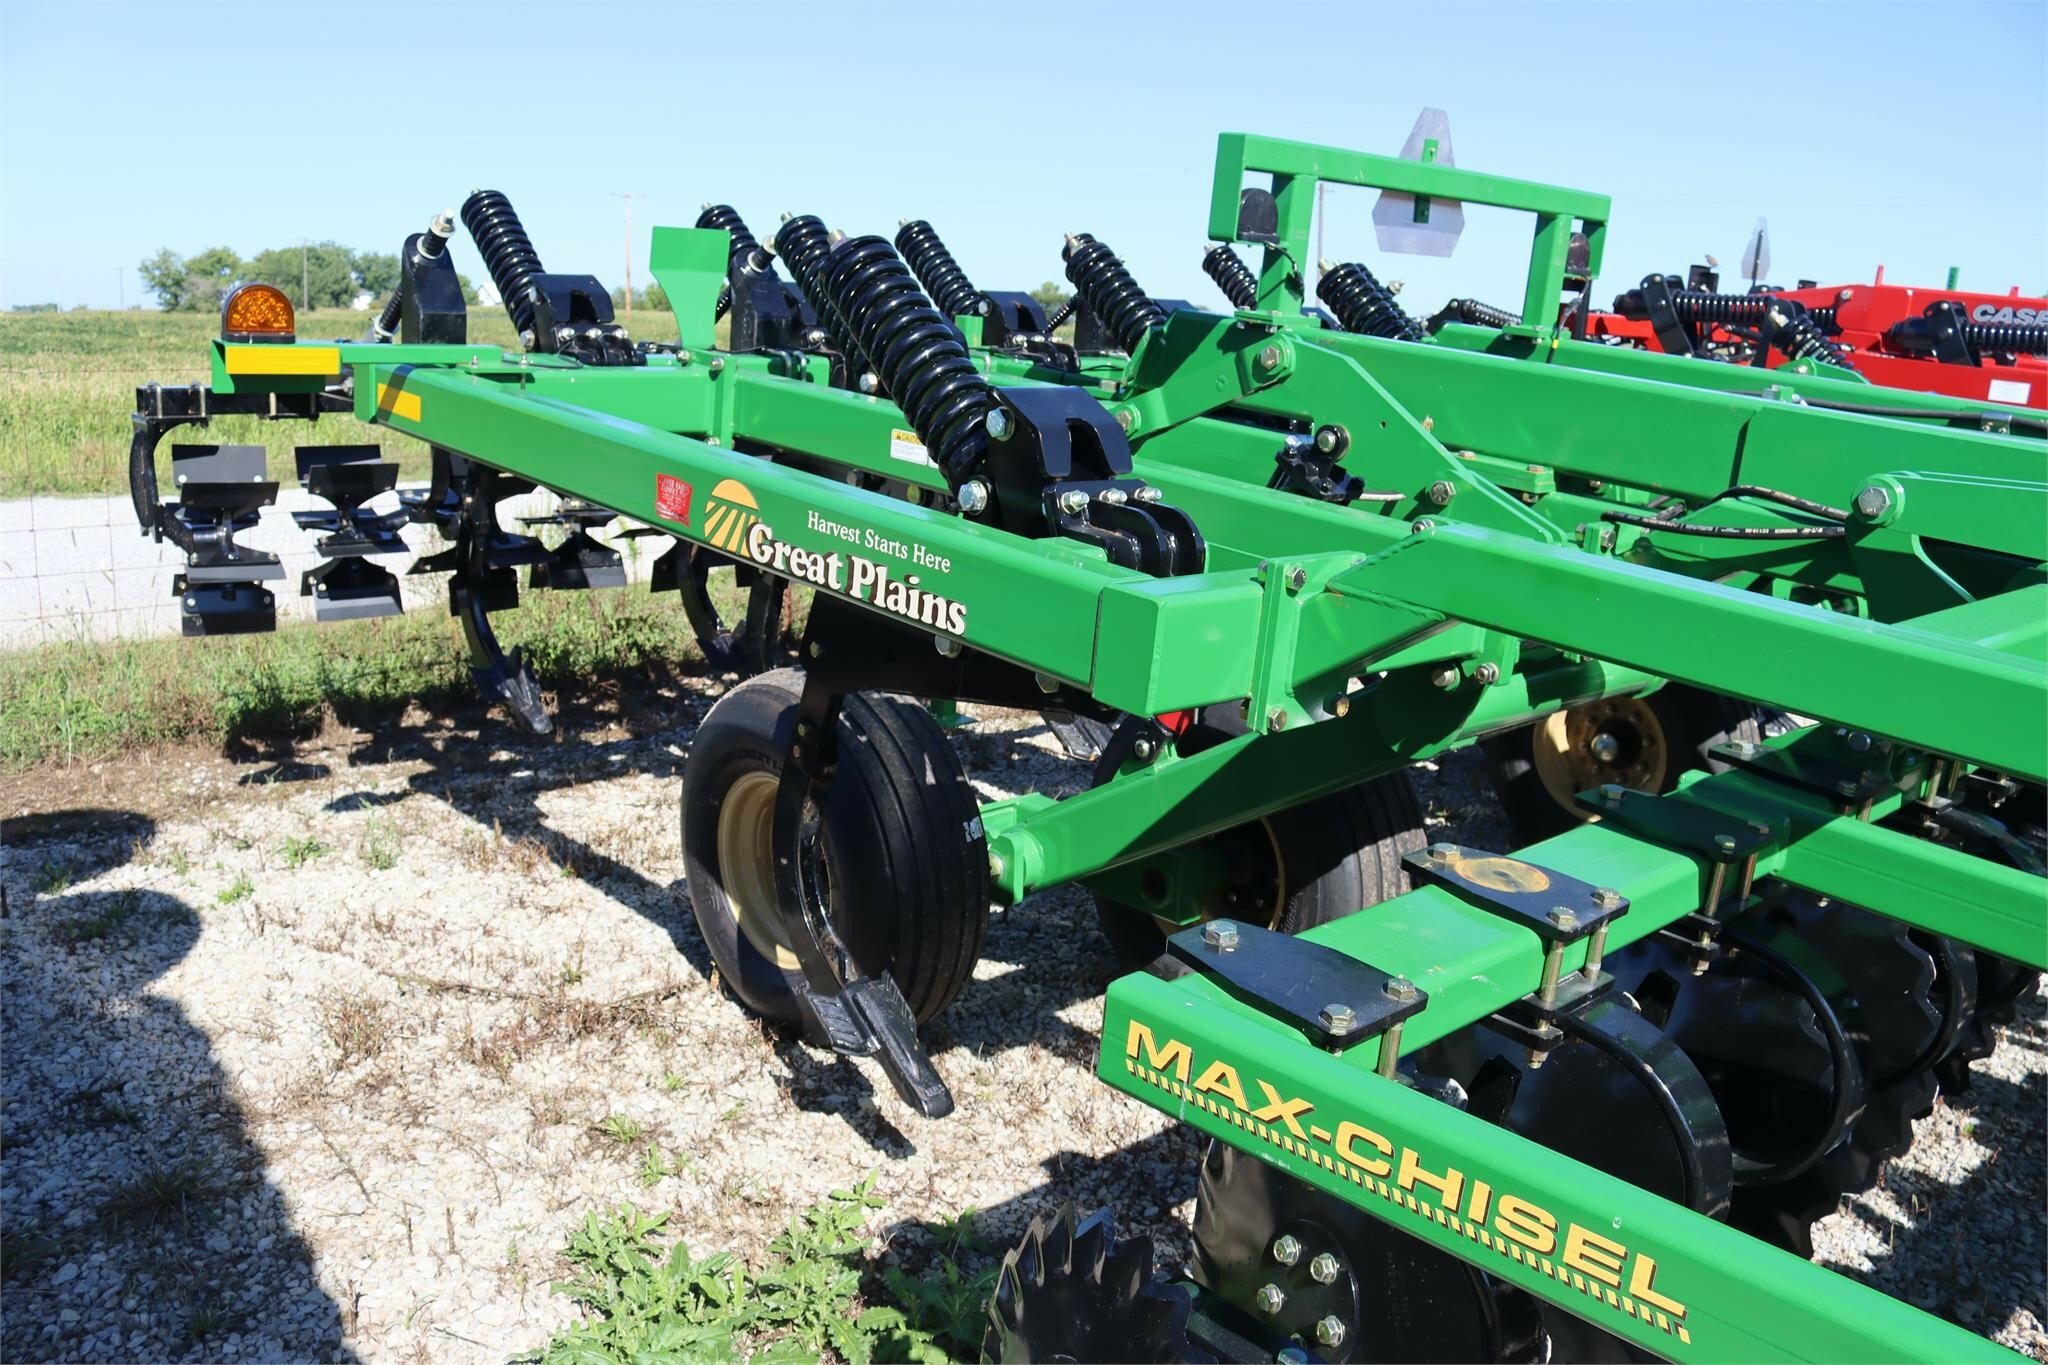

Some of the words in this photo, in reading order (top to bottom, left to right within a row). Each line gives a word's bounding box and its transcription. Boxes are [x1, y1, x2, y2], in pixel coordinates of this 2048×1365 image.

[1973, 304, 2048, 327] CASE
[747, 522, 843, 590] Great
[849, 554, 967, 635] Plains
[807, 510, 861, 543] Harvest
[865, 529, 908, 559] Starts
[914, 543, 951, 574] Here
[1125, 1019, 1687, 1320] MAX-CHISEL
